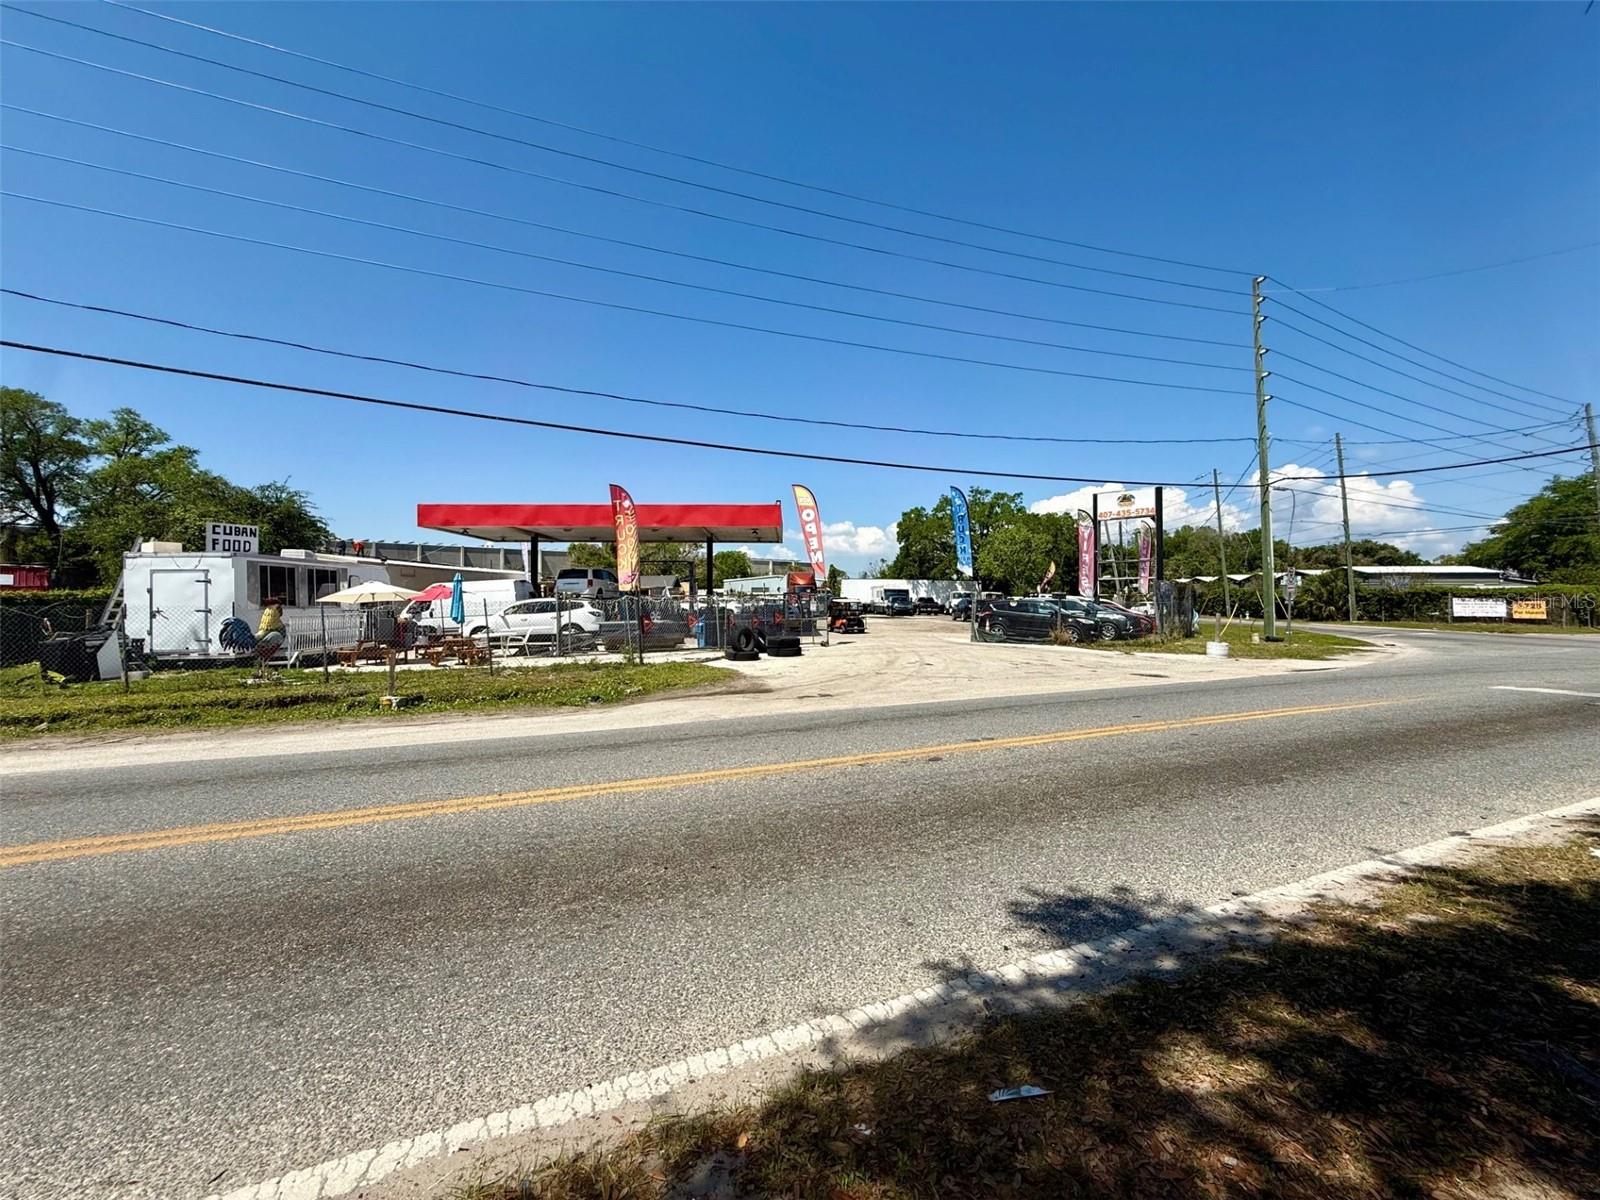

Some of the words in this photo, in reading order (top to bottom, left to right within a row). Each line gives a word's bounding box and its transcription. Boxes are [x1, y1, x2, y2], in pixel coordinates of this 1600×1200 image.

[1098, 507, 1155, 519] 407-435-5734
[212, 525, 257, 538] CUBAN
[212, 538, 251, 552] FOOD
